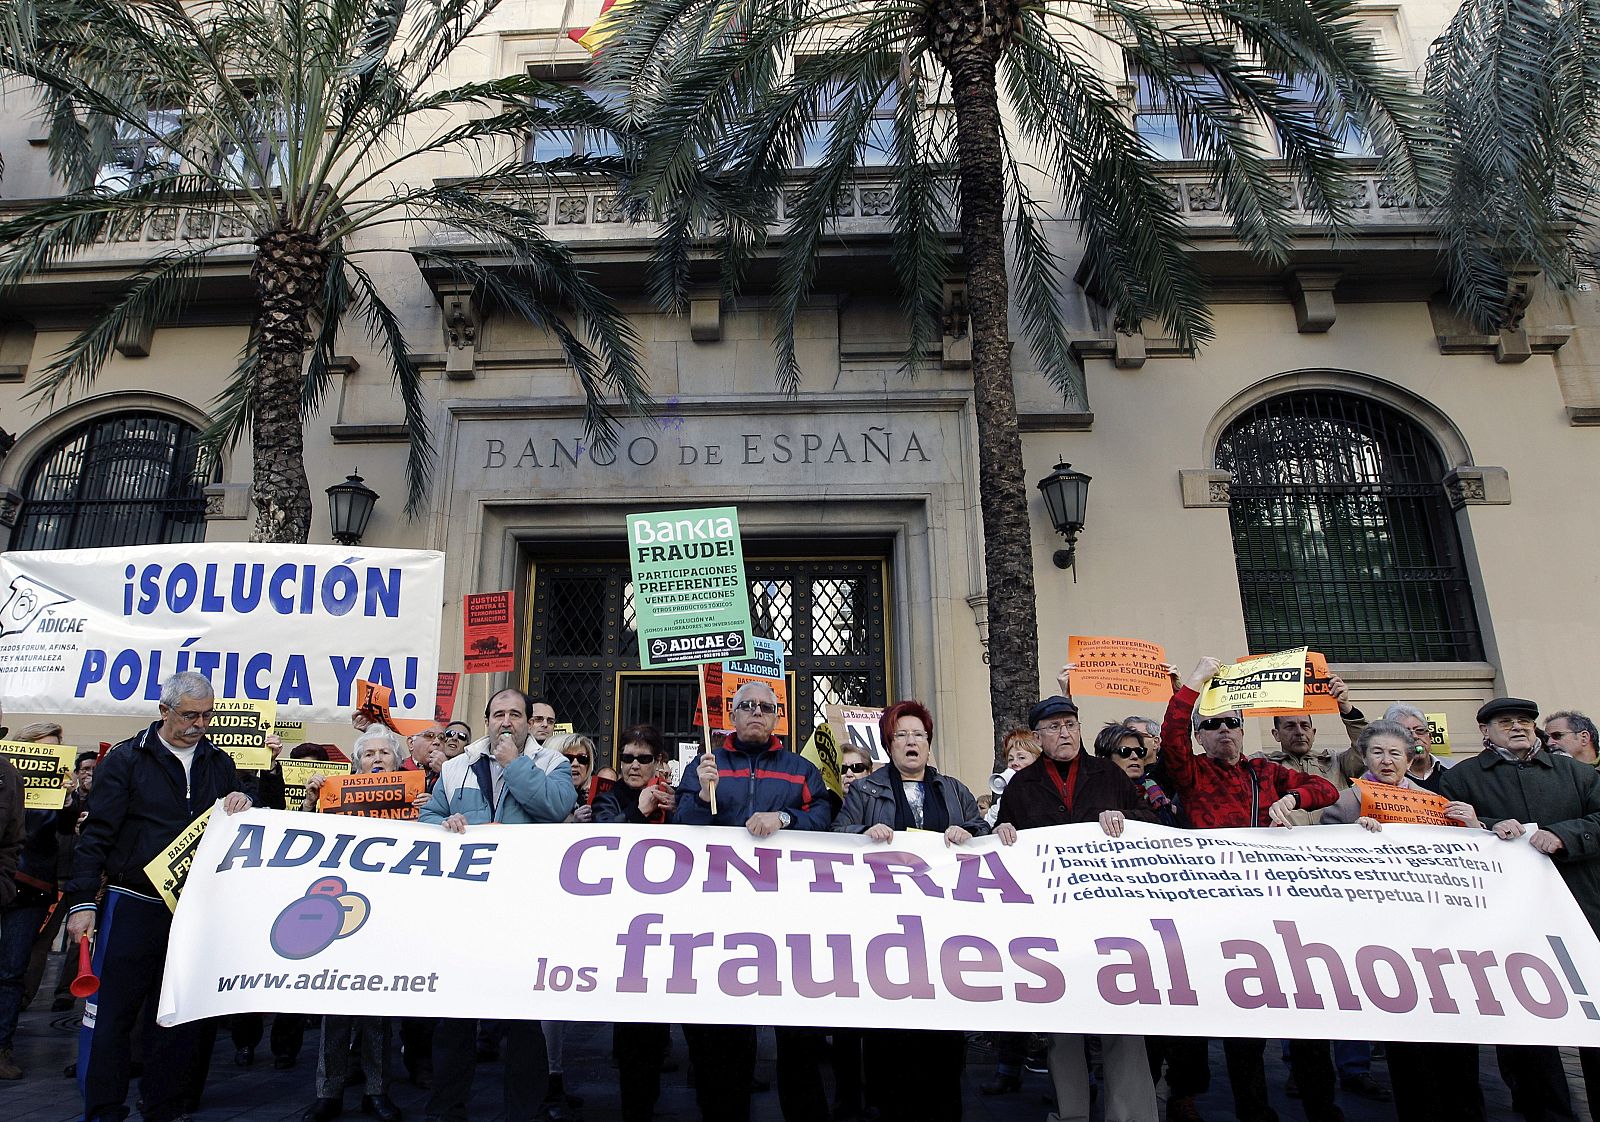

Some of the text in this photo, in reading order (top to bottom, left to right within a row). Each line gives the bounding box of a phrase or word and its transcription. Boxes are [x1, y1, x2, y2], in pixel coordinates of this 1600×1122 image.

[483, 426, 931, 468] BANCO DE ESPAÑA
[634, 518, 733, 544] Bankia
[637, 540, 734, 563] FRAUDE!
[638, 565, 737, 581] PARTICIPACIONES
[123, 556, 401, 618] ¡SOLUCIÓN
[640, 575, 738, 593] PREFERENTES
[471, 595, 506, 604] JUSTICIA
[645, 590, 735, 604] VENTA DE ACCIONES
[471, 609, 506, 617] TERRORISMO
[672, 603, 708, 611] PRODUCTOS
[708, 601, 733, 609] TÓXICOS
[37, 617, 88, 633] ADICAE
[471, 615, 506, 623] FINANCIERO
[670, 635, 725, 651] ADICAE
[1111, 640, 1159, 652] PREFERENTES
[731, 661, 743, 671] AL
[743, 663, 779, 676] AHORRO
[1080, 660, 1117, 668] EUROPA
[74, 637, 418, 709] POLÍTICA YA!
[1120, 667, 1167, 679] ESCUCHAR
[1106, 683, 1140, 692] ADICAE
[1228, 683, 1260, 692] ESPAÑOL
[1228, 692, 1257, 701] ADICAE
[313, 762, 348, 770] PREFERENTES
[343, 777, 374, 786] BASTA
[390, 775, 403, 783] DE
[343, 789, 402, 804] ABUSOS
[370, 807, 419, 819] BANCA
[1375, 802, 1412, 813] EUROPA
[167, 832, 195, 860] BASTA
[216, 824, 498, 882] ADICAE
[1055, 837, 1193, 854] participaciones
[1315, 843, 1465, 855] forum-afinsa-ayn
[558, 836, 1034, 904] CONTRA
[1059, 857, 1108, 869] banif
[1111, 854, 1215, 869] inmobiliaro
[1237, 851, 1385, 864] lehman-brothers
[1406, 856, 1490, 873] gescartera
[1067, 872, 1124, 885] deuda
[1126, 869, 1242, 884] subordinada
[1265, 867, 1352, 882] depósitos
[1354, 869, 1470, 888] estructurados
[1073, 886, 1145, 901] cédulas
[1146, 885, 1264, 902] hipotecarias
[1287, 885, 1344, 899] deuda
[1344, 888, 1424, 903] perpetua
[1444, 893, 1473, 908] ava
[533, 912, 1600, 1021] los fraudes al ahorro!
[217, 968, 439, 993] www.adicae.net
